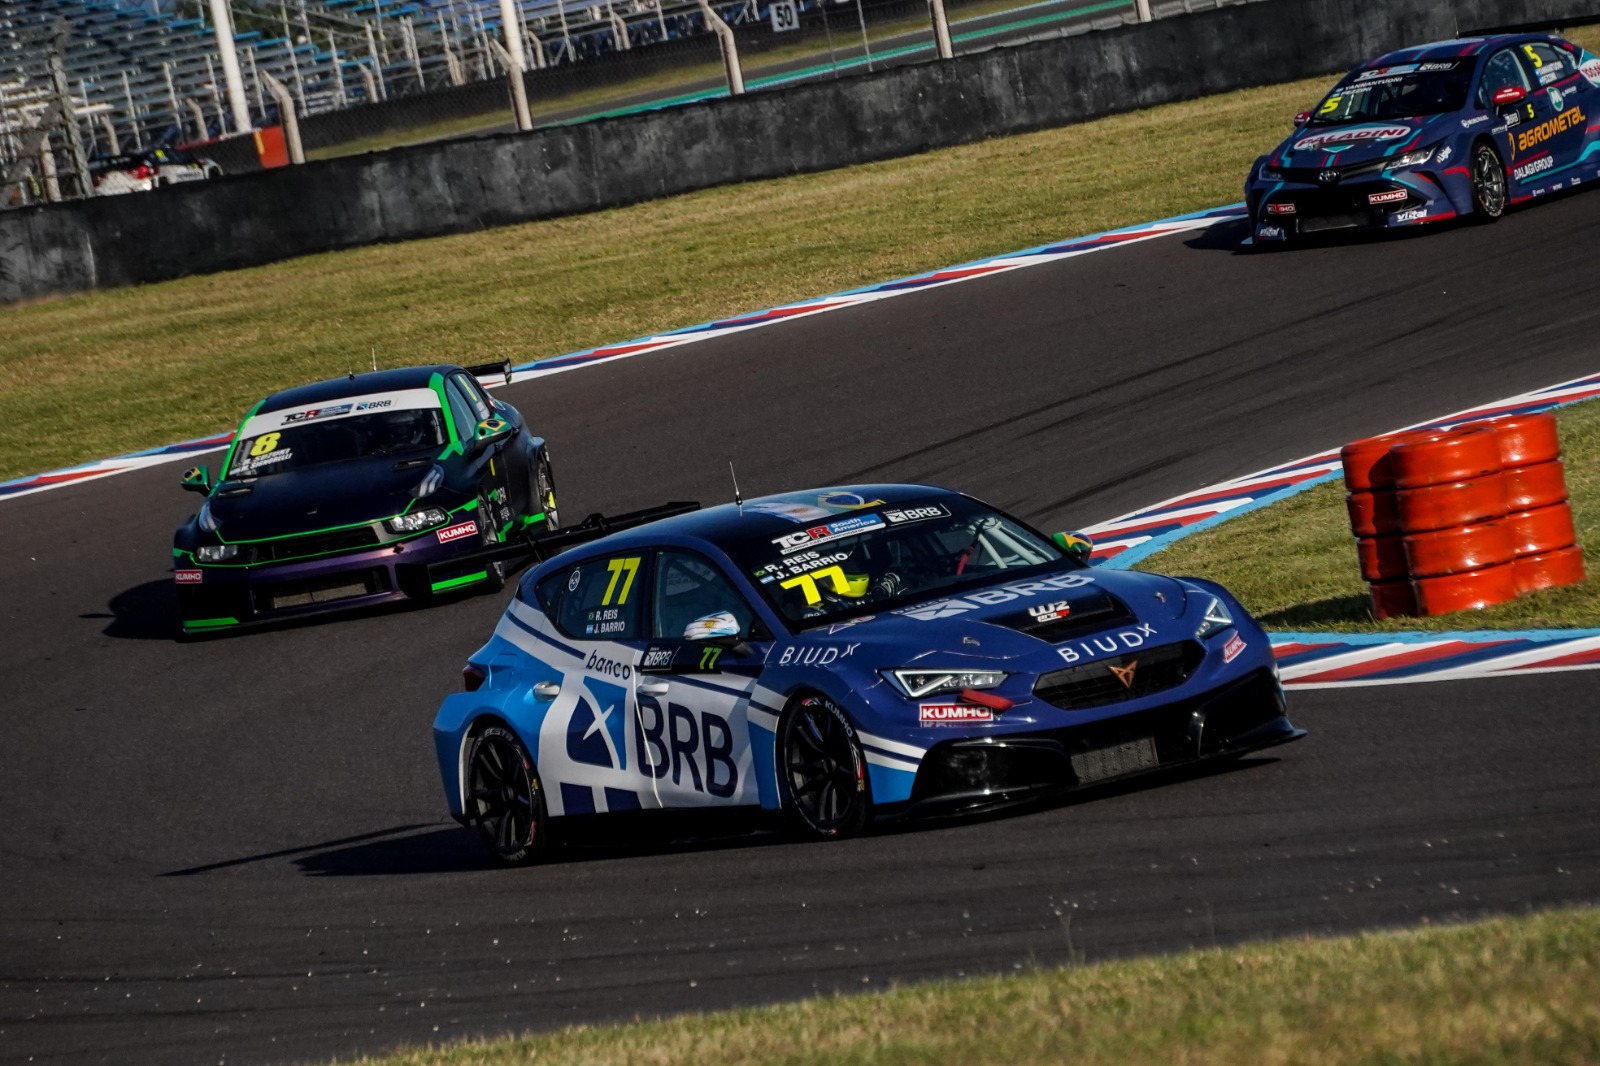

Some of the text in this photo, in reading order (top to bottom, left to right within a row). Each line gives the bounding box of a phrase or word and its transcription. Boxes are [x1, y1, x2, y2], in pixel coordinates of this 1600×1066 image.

[776, 5, 793, 27] 50
[1524, 45, 1543, 68] 5
[1320, 97, 1342, 114] 5
[1527, 103, 1535, 119] 5
[1297, 128, 1408, 147] PALADINI
[1534, 155, 1554, 173] GROUP
[1370, 191, 1406, 202] KUMHO
[368, 400, 392, 409] BRB
[283, 409, 321, 422] TCR
[250, 432, 281, 457] 8
[907, 506, 942, 520] BRB
[831, 517, 862, 528] South
[833, 519, 877, 533] America
[439, 523, 477, 541] KUMHO
[771, 525, 834, 549] TCR
[764, 551, 821, 573] R. REIS
[775, 552, 849, 580] J. BARRIO
[175, 573, 202, 581] KUMHO
[601, 557, 641, 606] 77
[780, 565, 851, 605] 77
[964, 574, 1095, 605] BRB
[595, 609, 618, 621] R. REIS
[1028, 600, 1070, 618] W2
[593, 621, 625, 634] J. BARRIO
[586, 649, 631, 680] banco
[652, 651, 673, 666] BRB
[699, 647, 723, 670] 77
[824, 700, 854, 738] KUMHO
[922, 705, 990, 719] KUMHO
[634, 692, 739, 798] BRB
